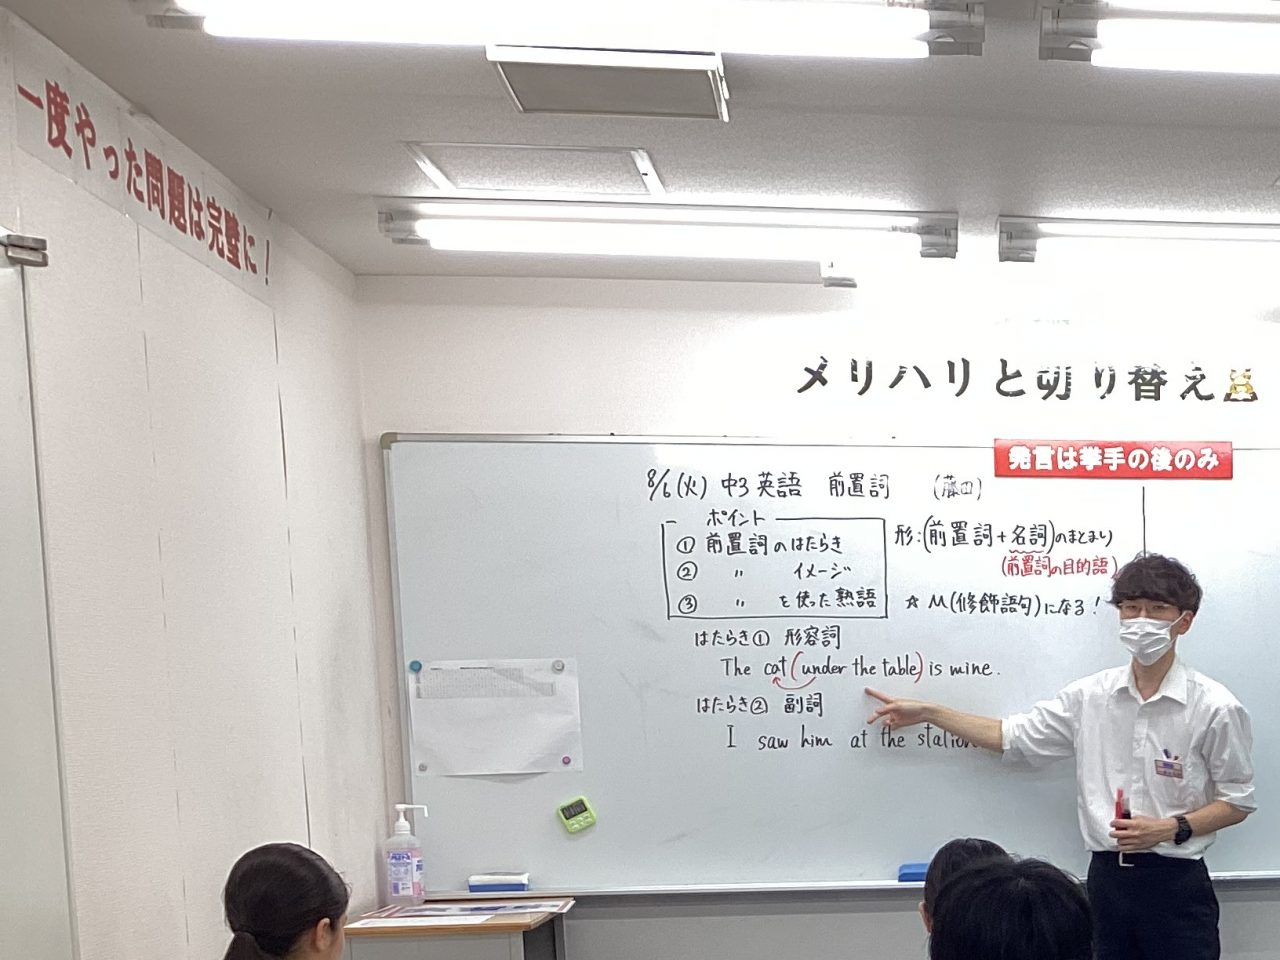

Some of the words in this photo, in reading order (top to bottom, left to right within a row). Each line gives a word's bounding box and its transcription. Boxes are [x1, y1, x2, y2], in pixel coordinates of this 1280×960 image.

[797, 355, 1215, 401] メリハリと切り替え
[1008, 444, 1220, 472] 発言は挙手の後のみ
[828, 471, 890, 499] 前置詞
[706, 508, 766, 527] ポイント
[793, 562, 853, 584] イメージ
[783, 624, 842, 649] 形容詞
[721, 656, 752, 677] The
[763, 656, 787, 676] cat
[851, 655, 877, 677] the
[928, 660, 943, 677] is
[783, 692, 824, 717] 副詞
[726, 724, 737, 748] I
[758, 735, 789, 750] saw
[800, 724, 833, 748] him
[850, 728, 868, 748] at
[881, 725, 906, 748] the
